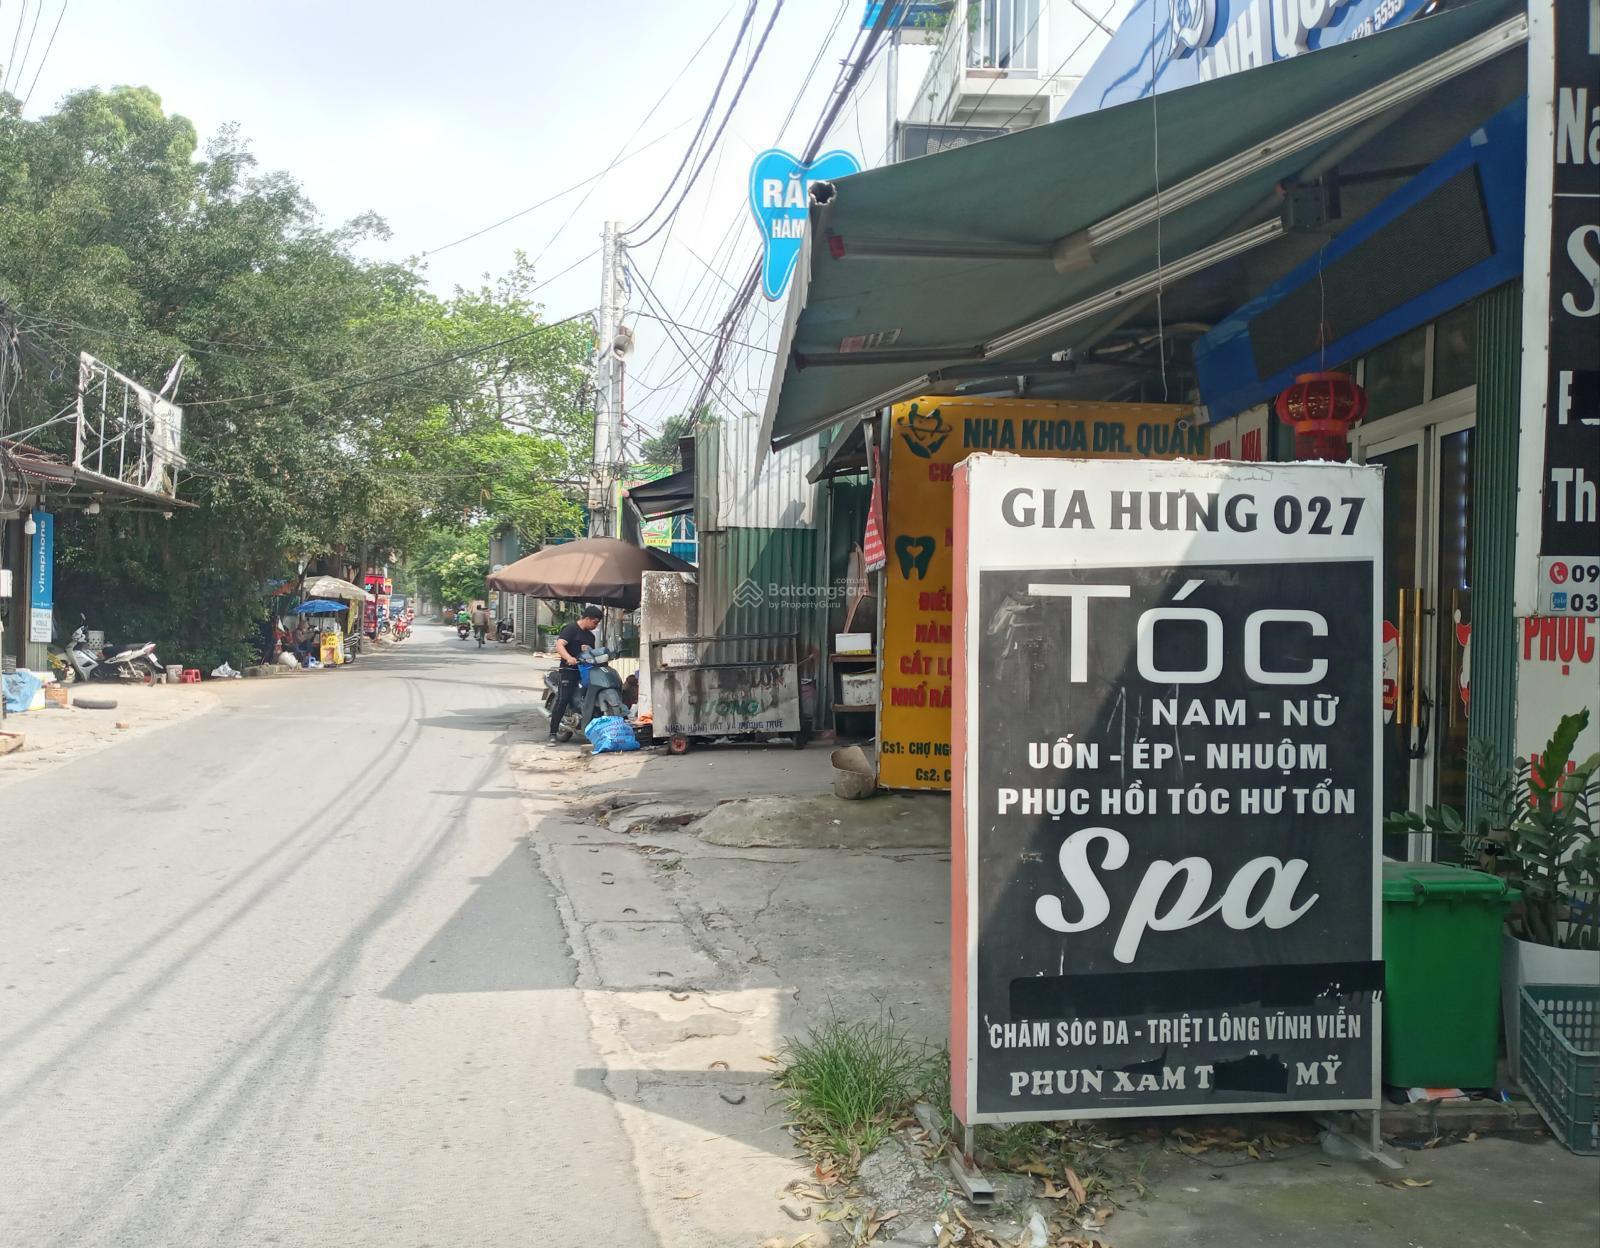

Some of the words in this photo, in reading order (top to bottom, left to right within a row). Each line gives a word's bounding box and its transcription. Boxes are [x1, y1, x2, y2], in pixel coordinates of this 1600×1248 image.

[963, 417, 1015, 449] NHA
[1021, 419, 1088, 451] KHOA
[1093, 421, 1132, 453] DR.
[1001, 488, 1096, 530] GIA
[1110, 490, 1259, 533] HƯNG
[1273, 495, 1367, 536] 027
[1570, 593, 1599, 612] 03
[1028, 579, 1329, 685] TÓC
[1152, 698, 1246, 726] NAM
[1284, 694, 1339, 726] NỮ
[909, 742, 931, 758] CHỢ
[1028, 733, 1098, 769] UỐN
[1133, 738, 1173, 769] ÉP
[1206, 738, 1327, 776] NHUỘM
[998, 788, 1090, 821] PHỤC
[1101, 778, 1157, 815] HỒI
[1168, 783, 1233, 815] TÓC
[1240, 786, 1287, 815] HƯ
[1293, 777, 1356, 815] TỔN
[1035, 826, 1320, 964] Spa
[1057, 1015, 1097, 1047] SÓC
[1103, 1018, 1129, 1046] DA
[1147, 1013, 1202, 1049] TRIỆT
[1208, 1012, 1260, 1042] LÔNG
[1265, 1010, 1312, 1040] VĨNH
[1316, 1005, 1361, 1039] VIỄN
[1010, 1069, 1104, 1097] PHUN
[1296, 1055, 1342, 1086] MỸ
